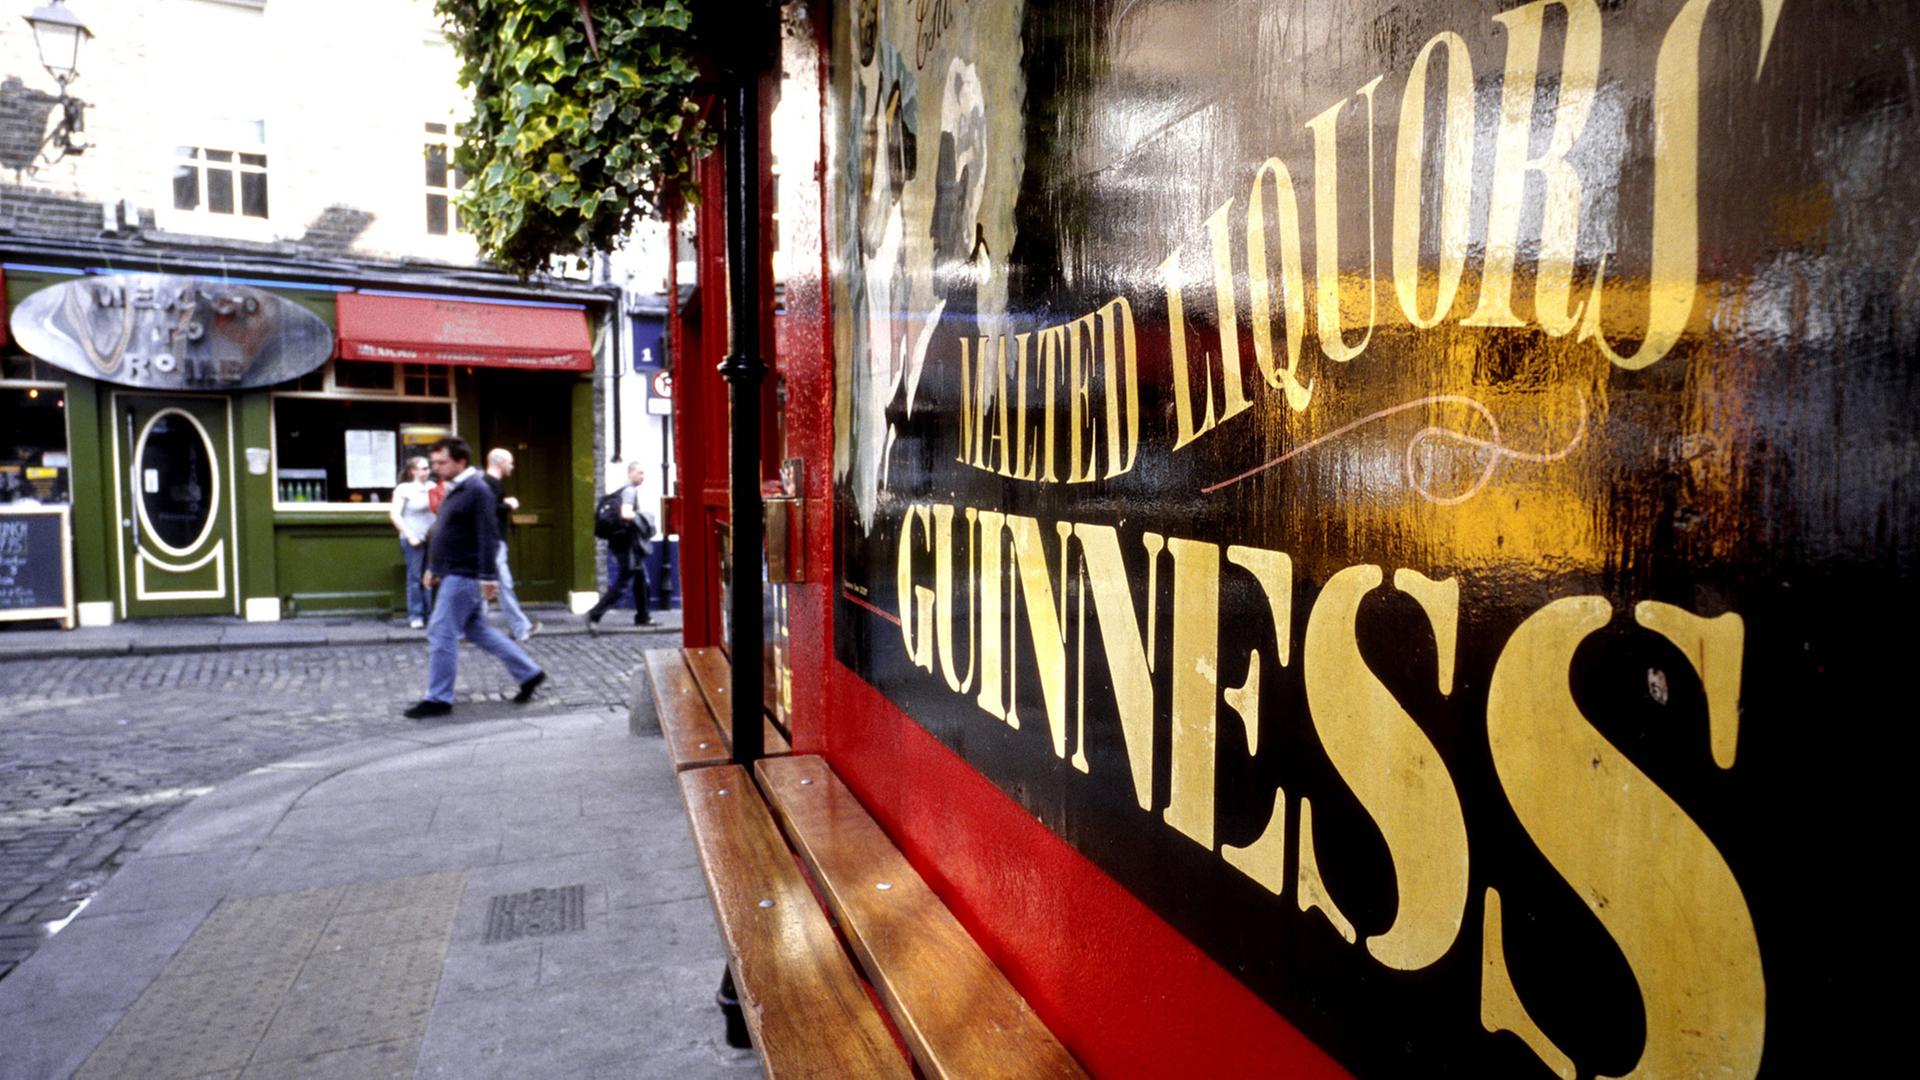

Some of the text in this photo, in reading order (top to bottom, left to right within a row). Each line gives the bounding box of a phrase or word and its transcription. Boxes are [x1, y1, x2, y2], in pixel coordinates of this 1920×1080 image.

[642, 348, 653, 361] 1
[956, 0, 1784, 484] MALTED LIQUORS
[897, 503, 1766, 1080] GUINNESS
